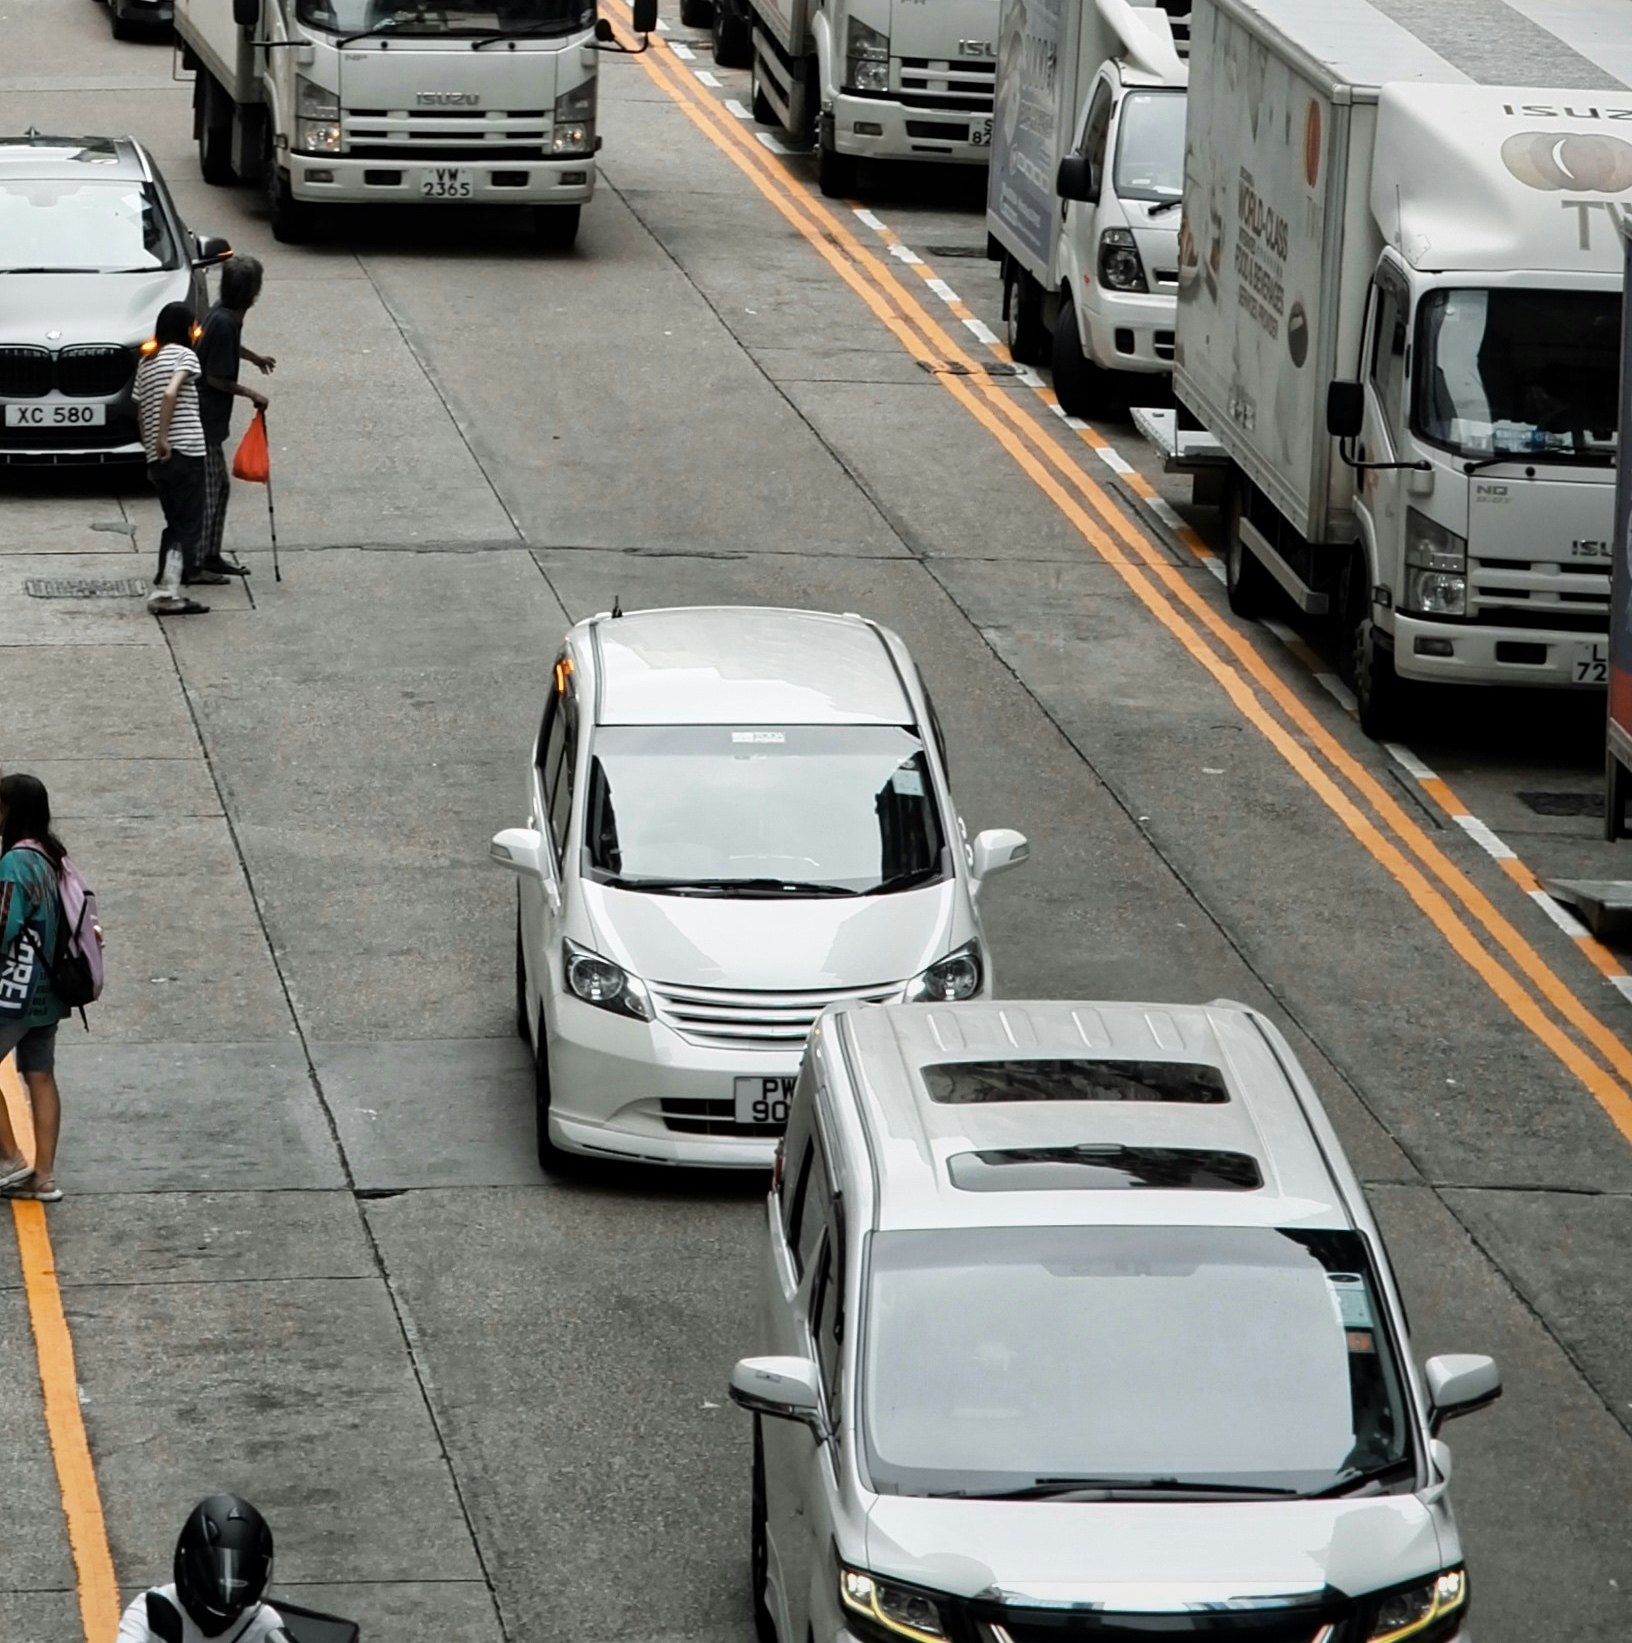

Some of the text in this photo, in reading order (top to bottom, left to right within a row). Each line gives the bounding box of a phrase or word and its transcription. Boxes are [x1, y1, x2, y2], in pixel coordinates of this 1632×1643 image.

[416, 92, 480, 106] ISUZU
[436, 168, 459, 181] VW
[423, 183, 470, 196] 2365
[18, 407, 93, 424] XC 580
[1577, 663, 1607, 682] 72
